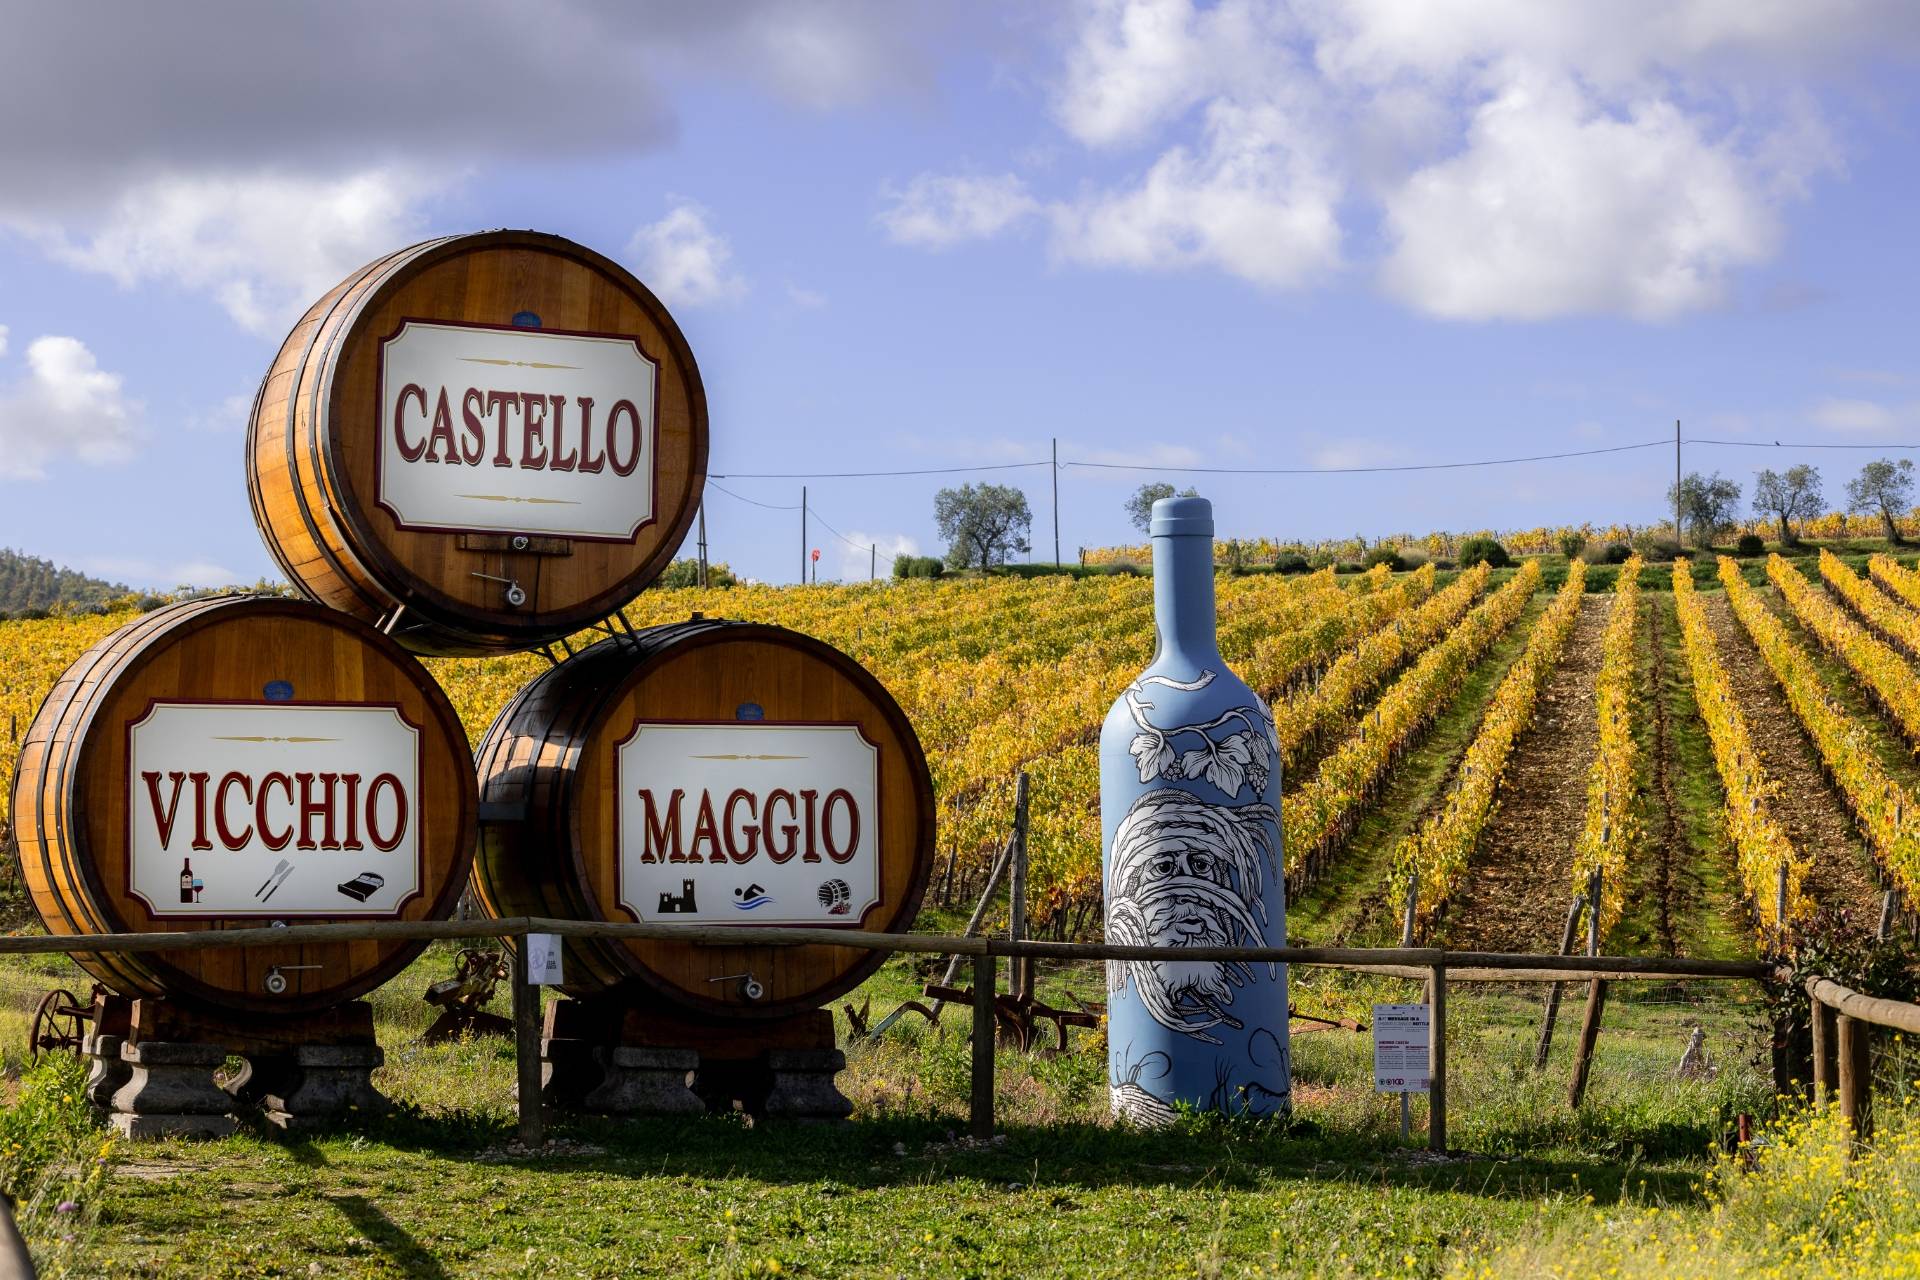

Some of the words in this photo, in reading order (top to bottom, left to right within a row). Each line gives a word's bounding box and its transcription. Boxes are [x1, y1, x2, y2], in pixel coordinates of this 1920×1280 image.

[394, 383, 643, 477] CASTELLO
[141, 770, 408, 852] VICCHIO
[638, 788, 860, 865] MAGGIO
